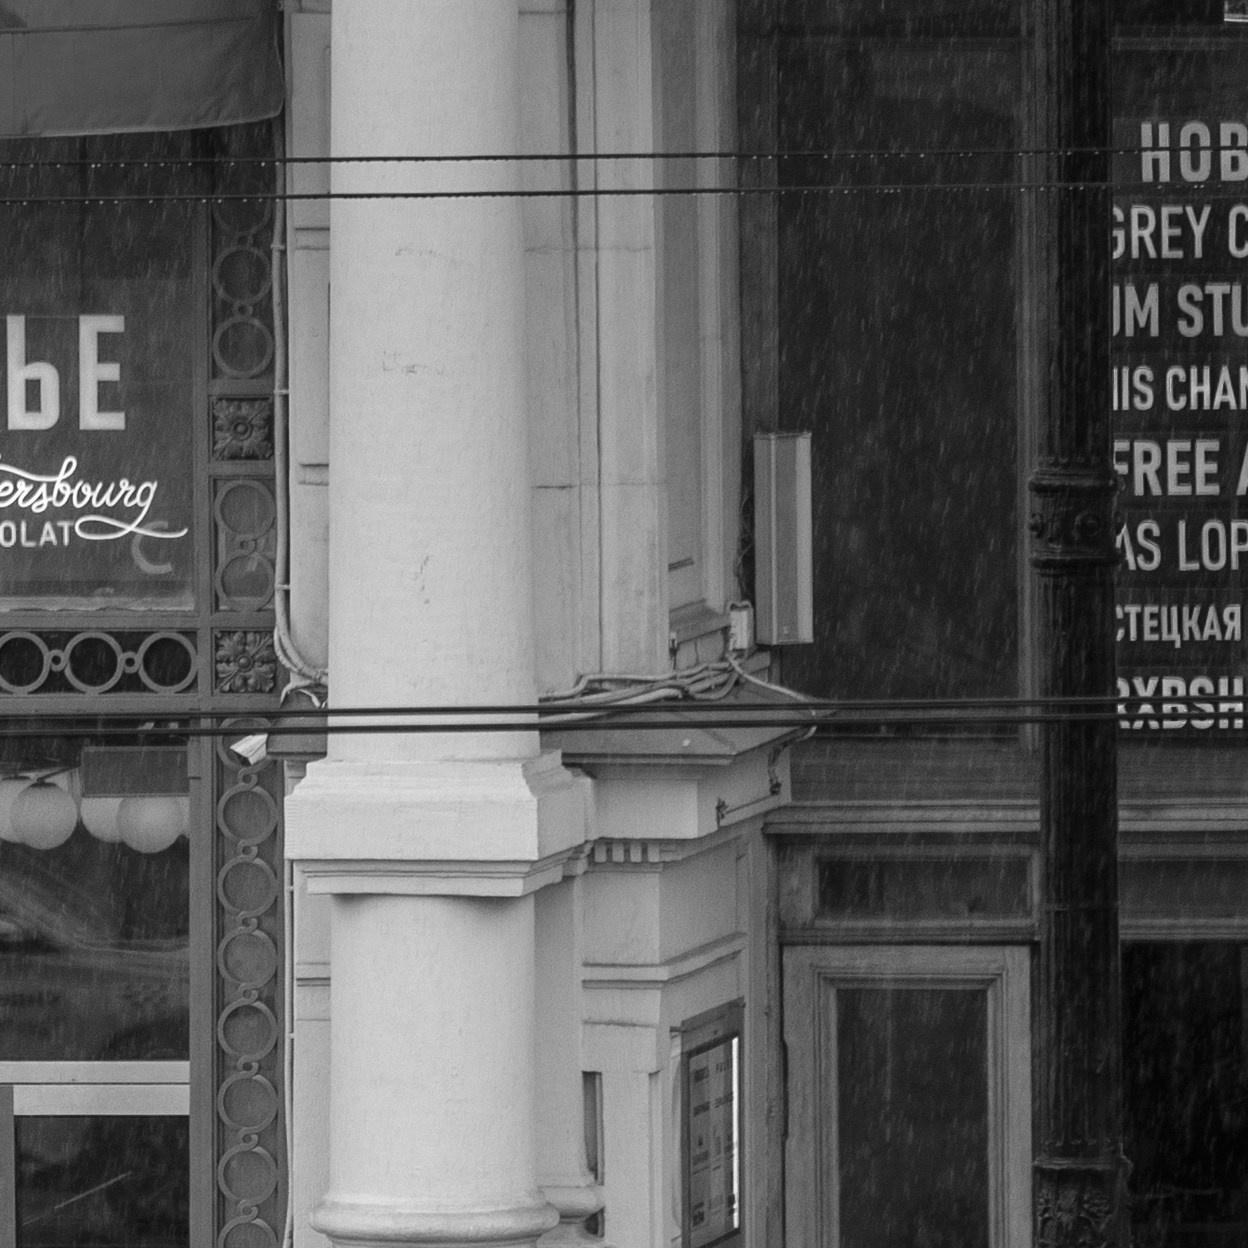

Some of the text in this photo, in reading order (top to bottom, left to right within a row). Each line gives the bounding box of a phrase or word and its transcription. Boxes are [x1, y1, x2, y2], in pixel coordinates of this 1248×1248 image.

[1112, 283, 1159, 337] M
[1112, 365, 1154, 411] IS
[1113, 439, 1221, 496] FREE
